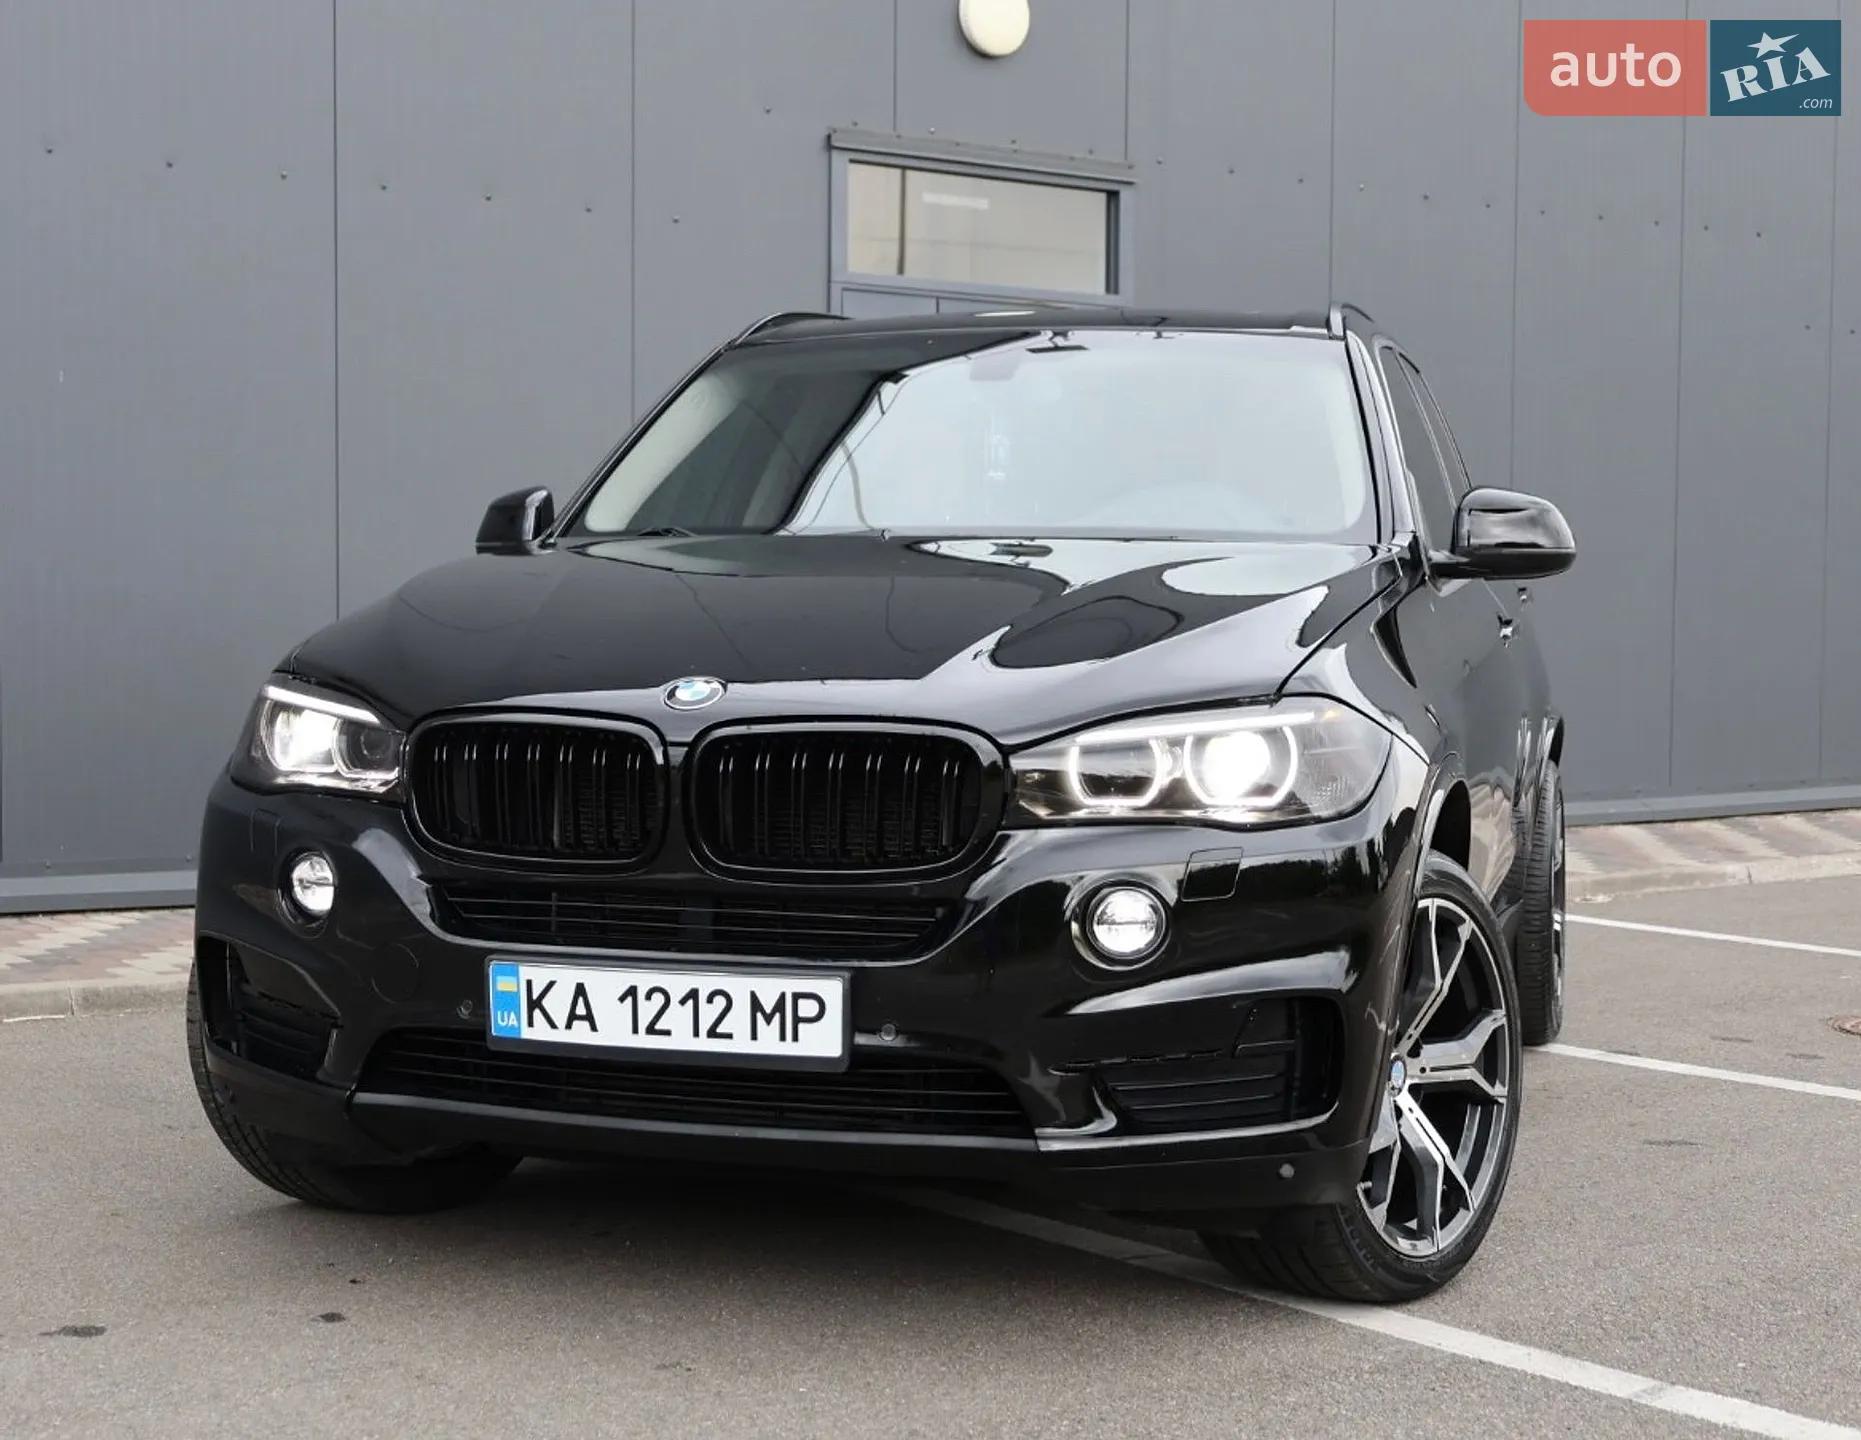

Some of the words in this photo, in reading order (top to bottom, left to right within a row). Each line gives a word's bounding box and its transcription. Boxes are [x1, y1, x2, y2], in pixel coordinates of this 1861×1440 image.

[497, 1010, 519, 1027] UA
[526, 979, 599, 1033] KA
[617, 985, 734, 1040] 1212
[750, 990, 827, 1043] MP
